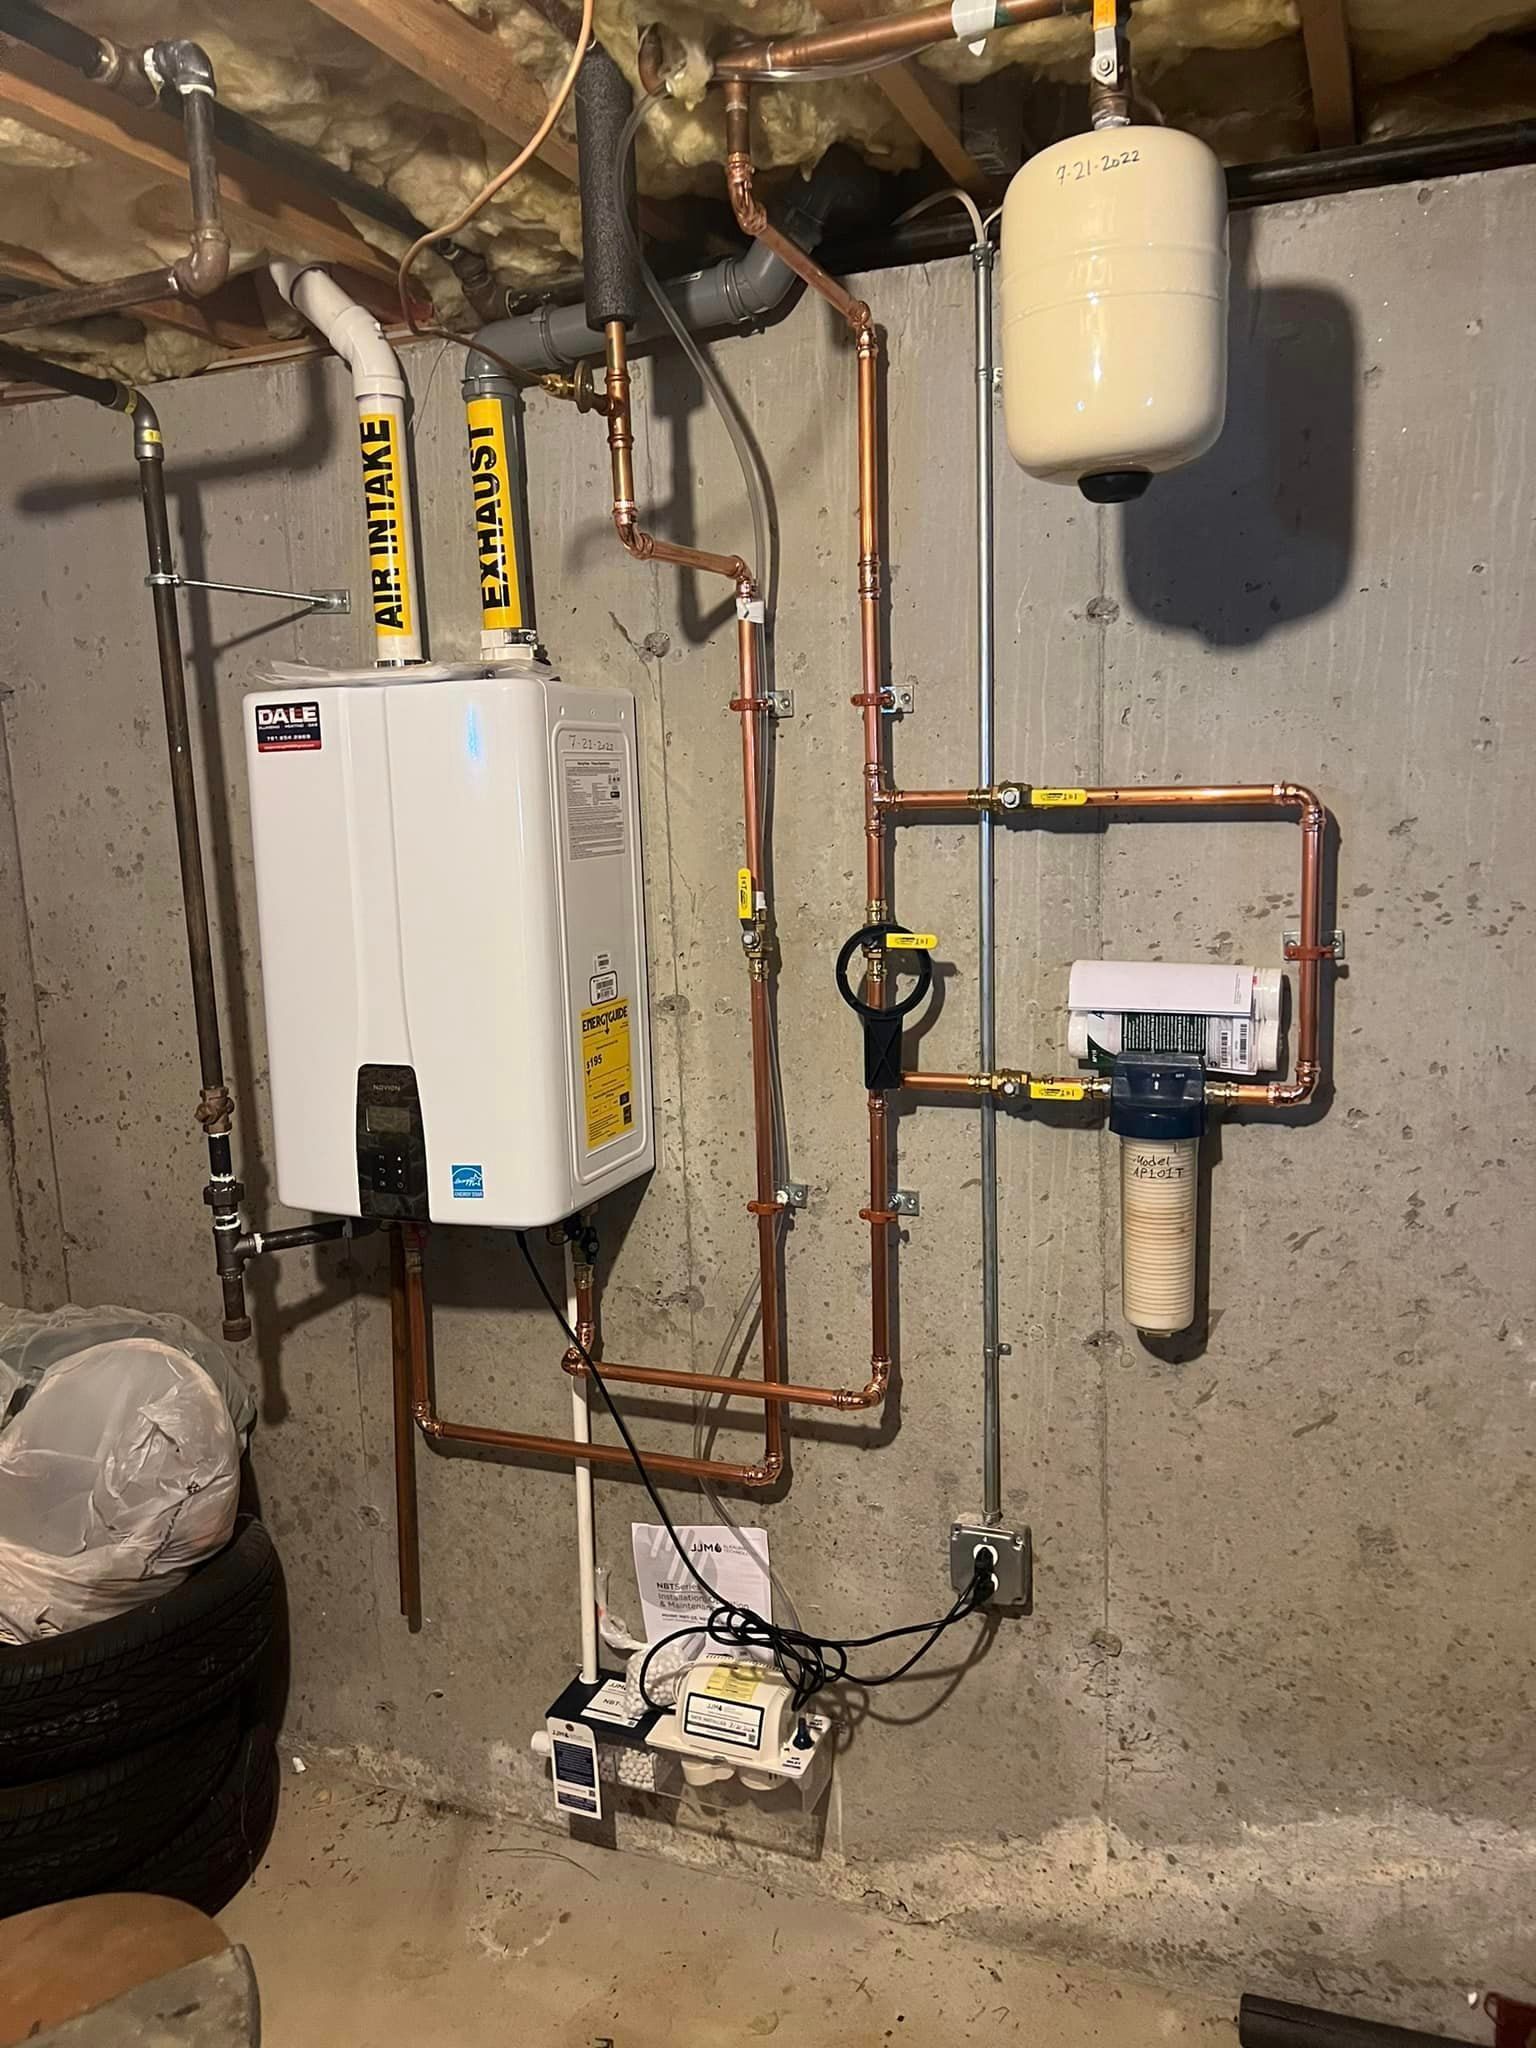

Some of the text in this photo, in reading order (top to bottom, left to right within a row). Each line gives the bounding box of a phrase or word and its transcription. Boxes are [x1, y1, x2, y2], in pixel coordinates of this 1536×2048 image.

[360, 420, 404, 629] AIR INTAKE
[468, 424, 510, 610] EXHAUST
[258, 706, 318, 725] DALE
[582, 1005, 628, 1034] ENERGYGUIDE
[690, 1543, 714, 1553] JJM
